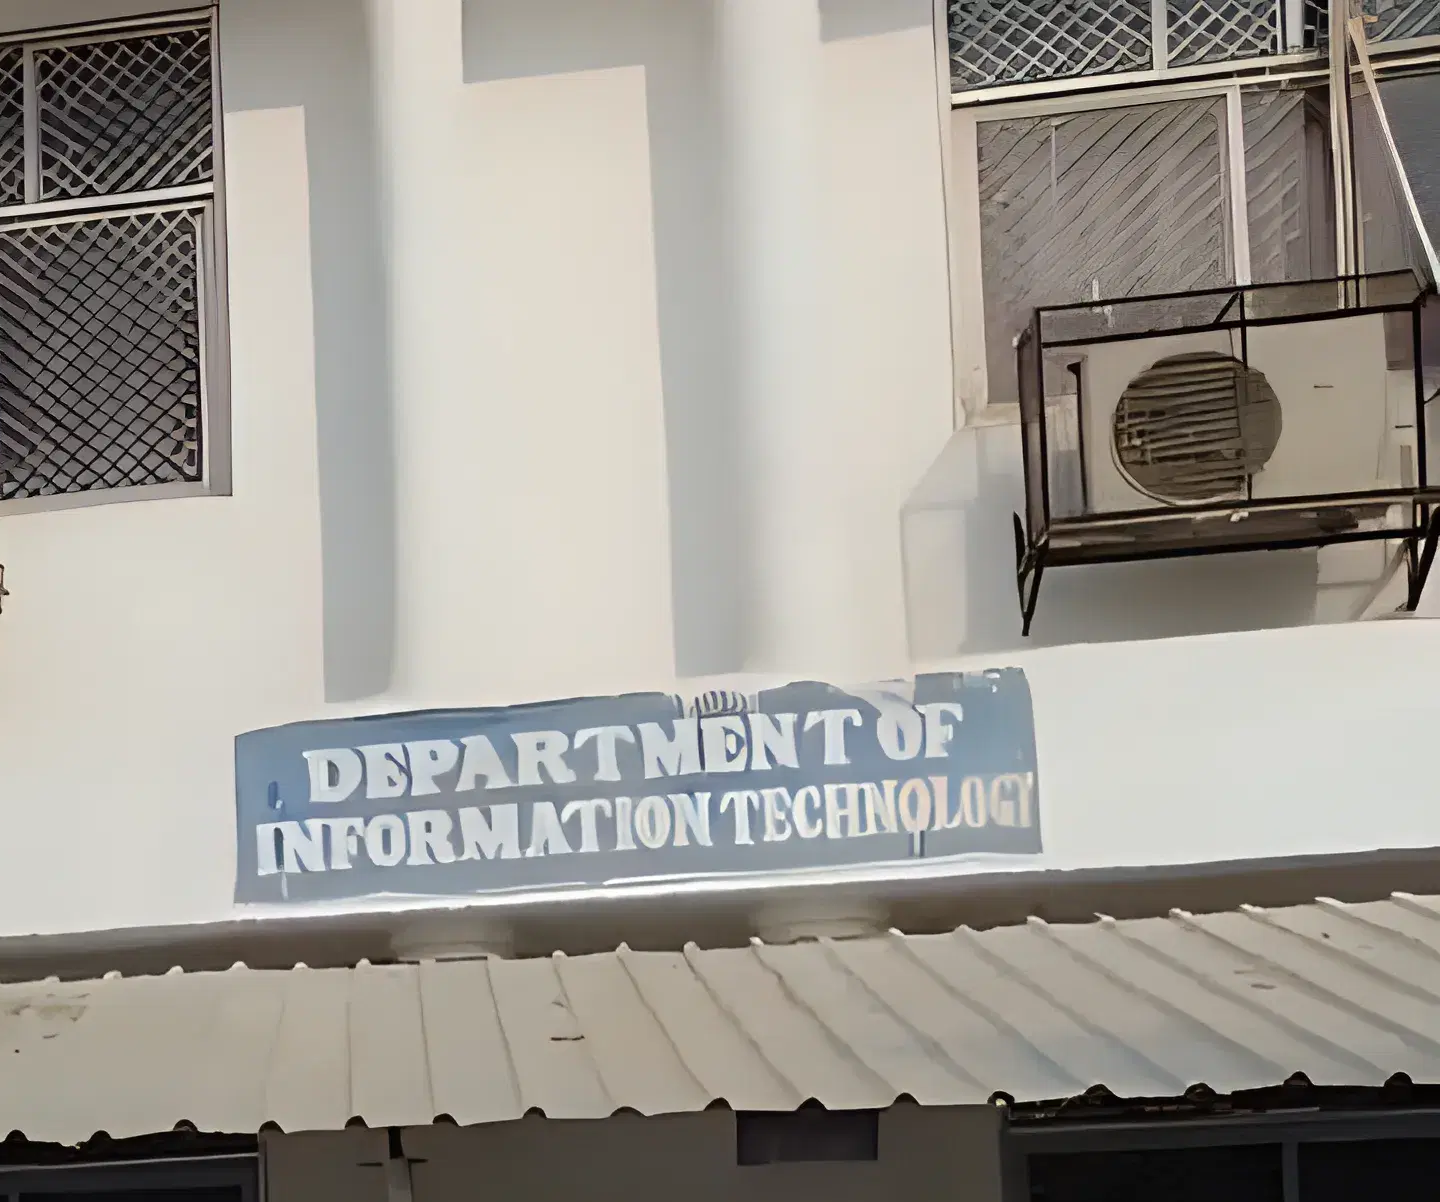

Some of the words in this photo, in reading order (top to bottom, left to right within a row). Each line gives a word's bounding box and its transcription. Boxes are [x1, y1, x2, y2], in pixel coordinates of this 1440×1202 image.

[302, 708, 862, 803] DEPARTMENT
[876, 702, 964, 761] OF
[256, 790, 714, 877] INFORMATION
[719, 771, 1034, 846] TECHNOLOGY
